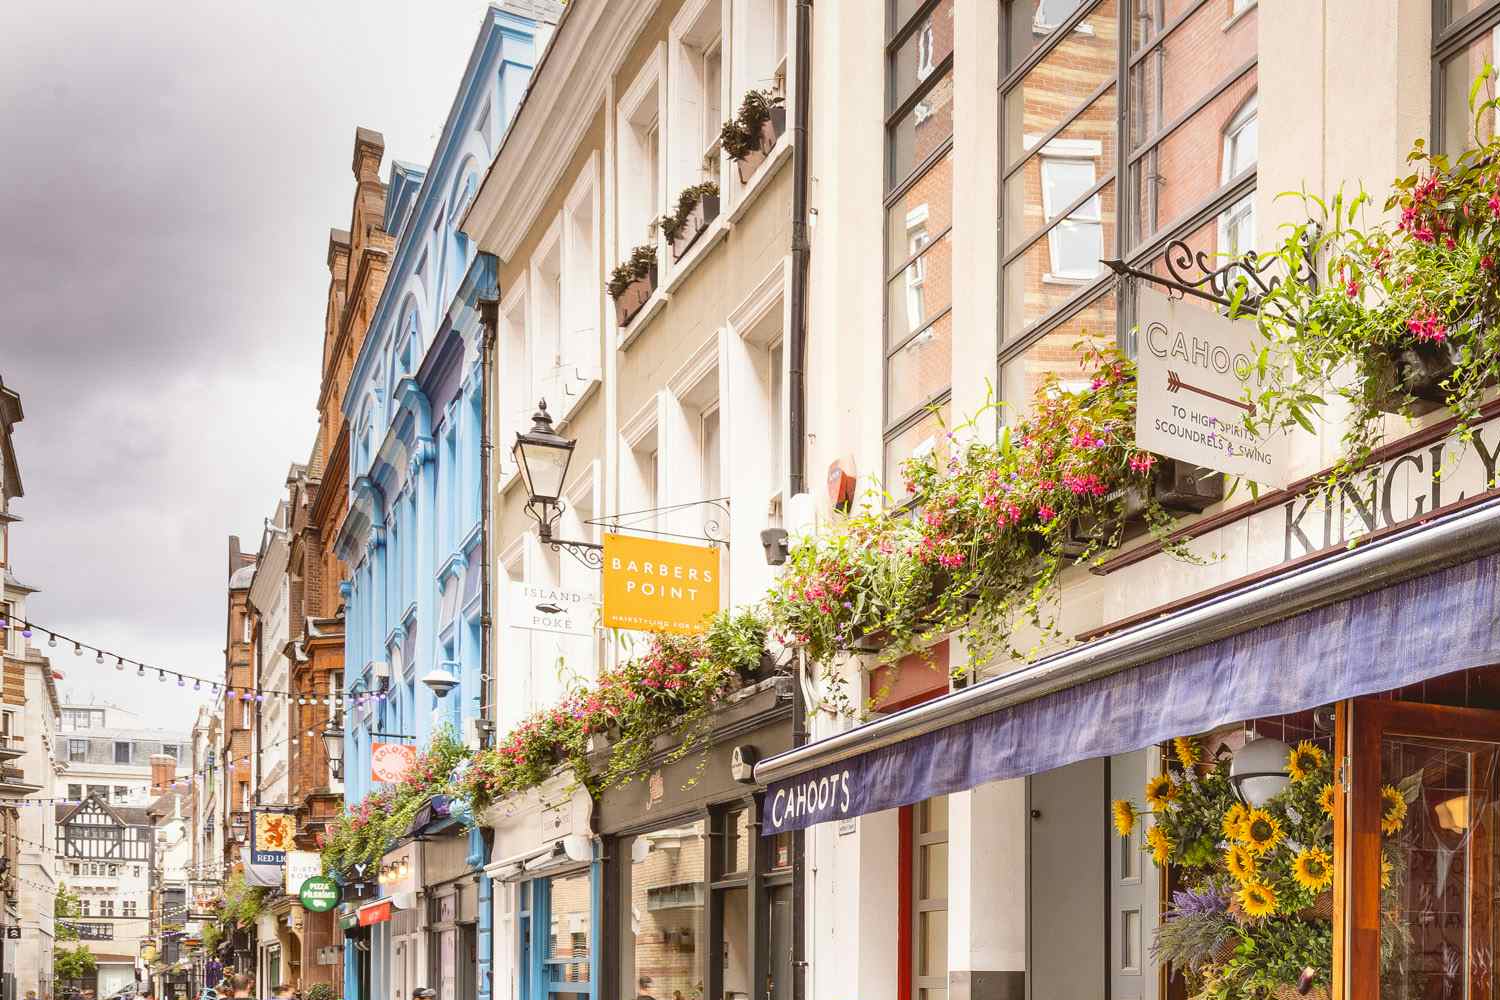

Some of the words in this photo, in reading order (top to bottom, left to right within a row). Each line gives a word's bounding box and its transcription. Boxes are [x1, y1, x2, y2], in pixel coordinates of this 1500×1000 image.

[1172, 404, 1187, 420] TO
[1190, 409, 1217, 429] HIGH
[1154, 418, 1224, 451] SCOUNDRELS
[611, 556, 713, 584] BARBERS
[523, 586, 582, 603] ISLAND
[626, 580, 699, 601] POINT
[771, 769, 850, 828] CAHOOTS
[257, 855, 275, 863] RED
